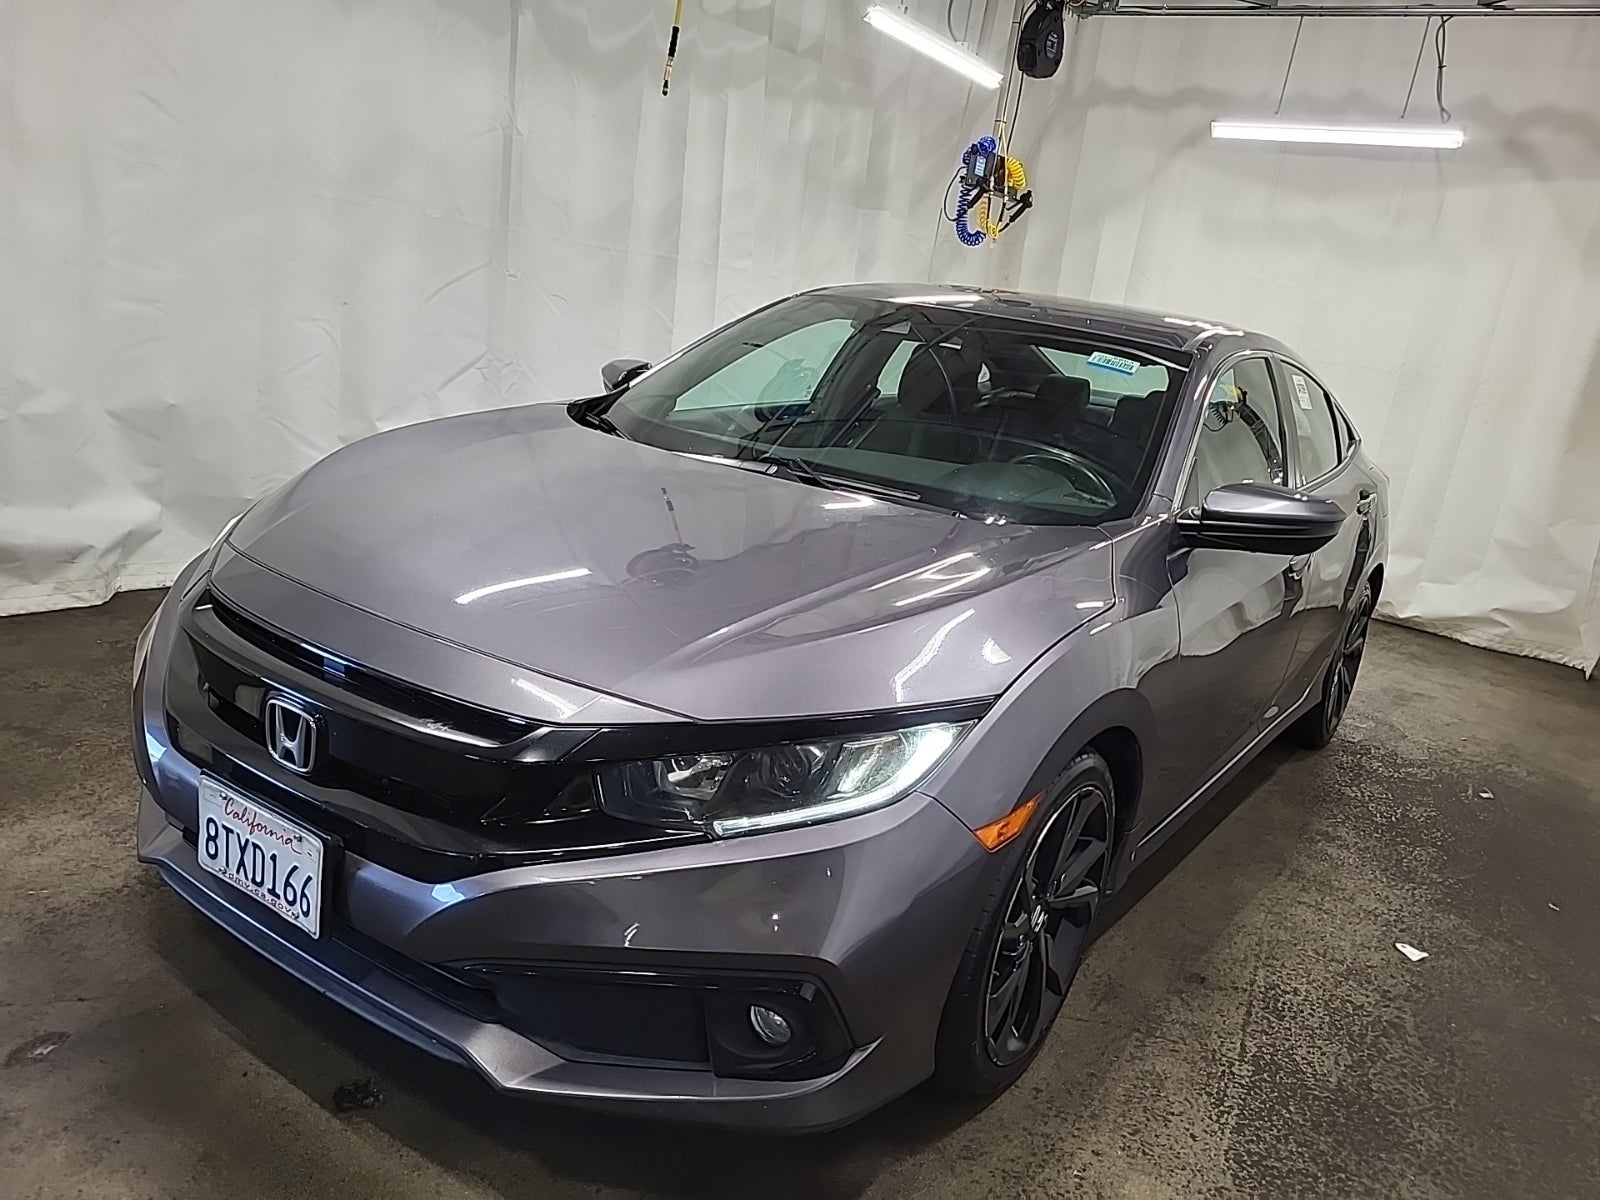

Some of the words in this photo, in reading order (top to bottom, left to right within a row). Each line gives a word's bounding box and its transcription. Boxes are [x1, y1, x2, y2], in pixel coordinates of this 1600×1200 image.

[224, 798, 302, 855] California
[205, 816, 313, 918] 8TXD166
[228, 872, 293, 914] dmv.ca.gov
